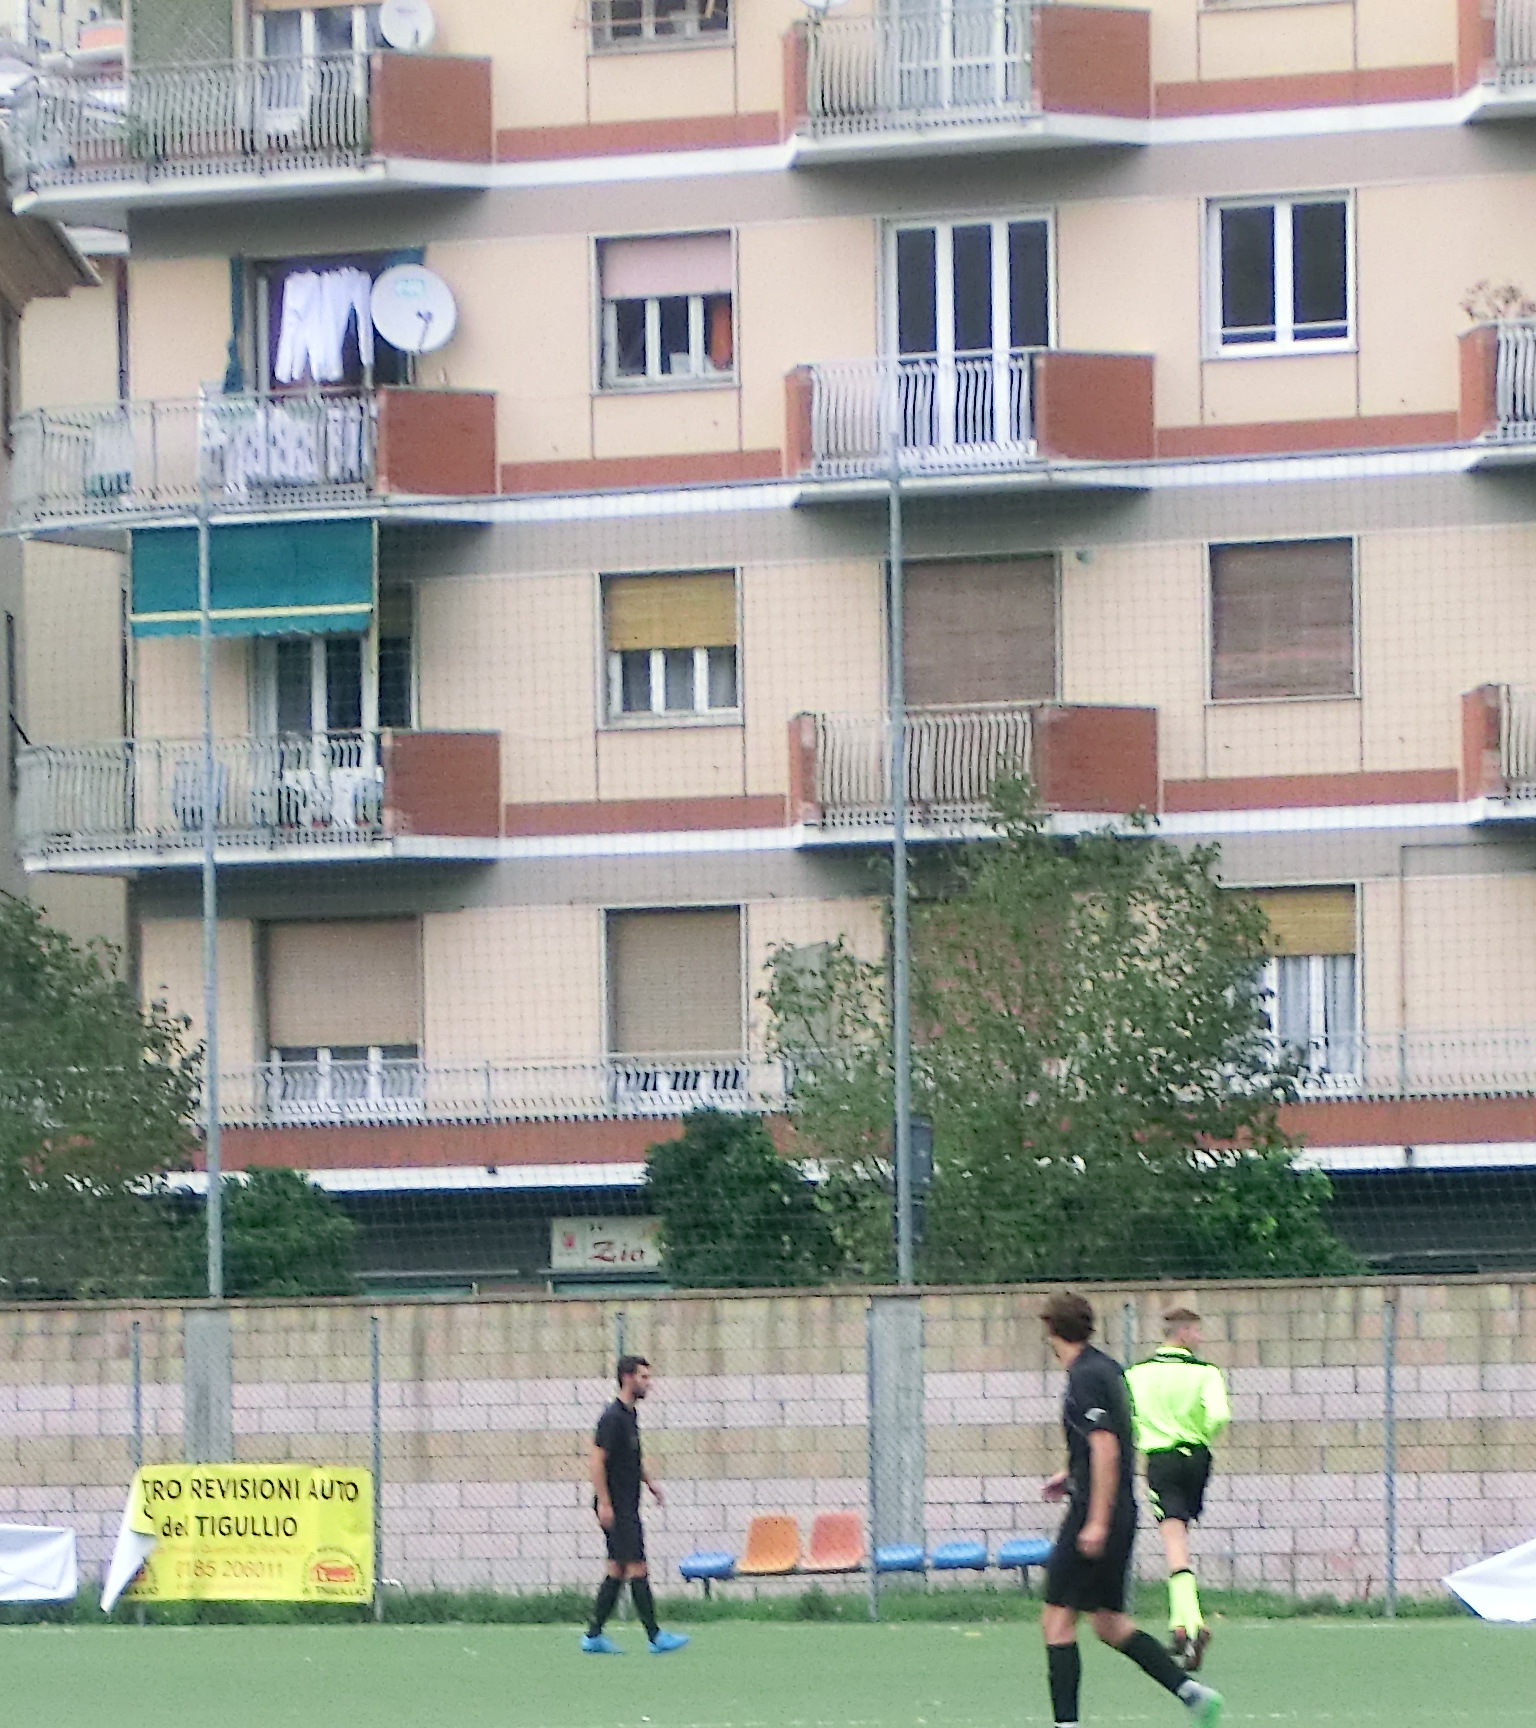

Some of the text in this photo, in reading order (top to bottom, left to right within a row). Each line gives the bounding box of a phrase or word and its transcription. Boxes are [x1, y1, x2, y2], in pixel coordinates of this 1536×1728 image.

[191, 1478, 300, 1500] REVISIONI
[308, 1478, 360, 1502] AUTO
[196, 1515, 298, 1537] TIGULLIO
